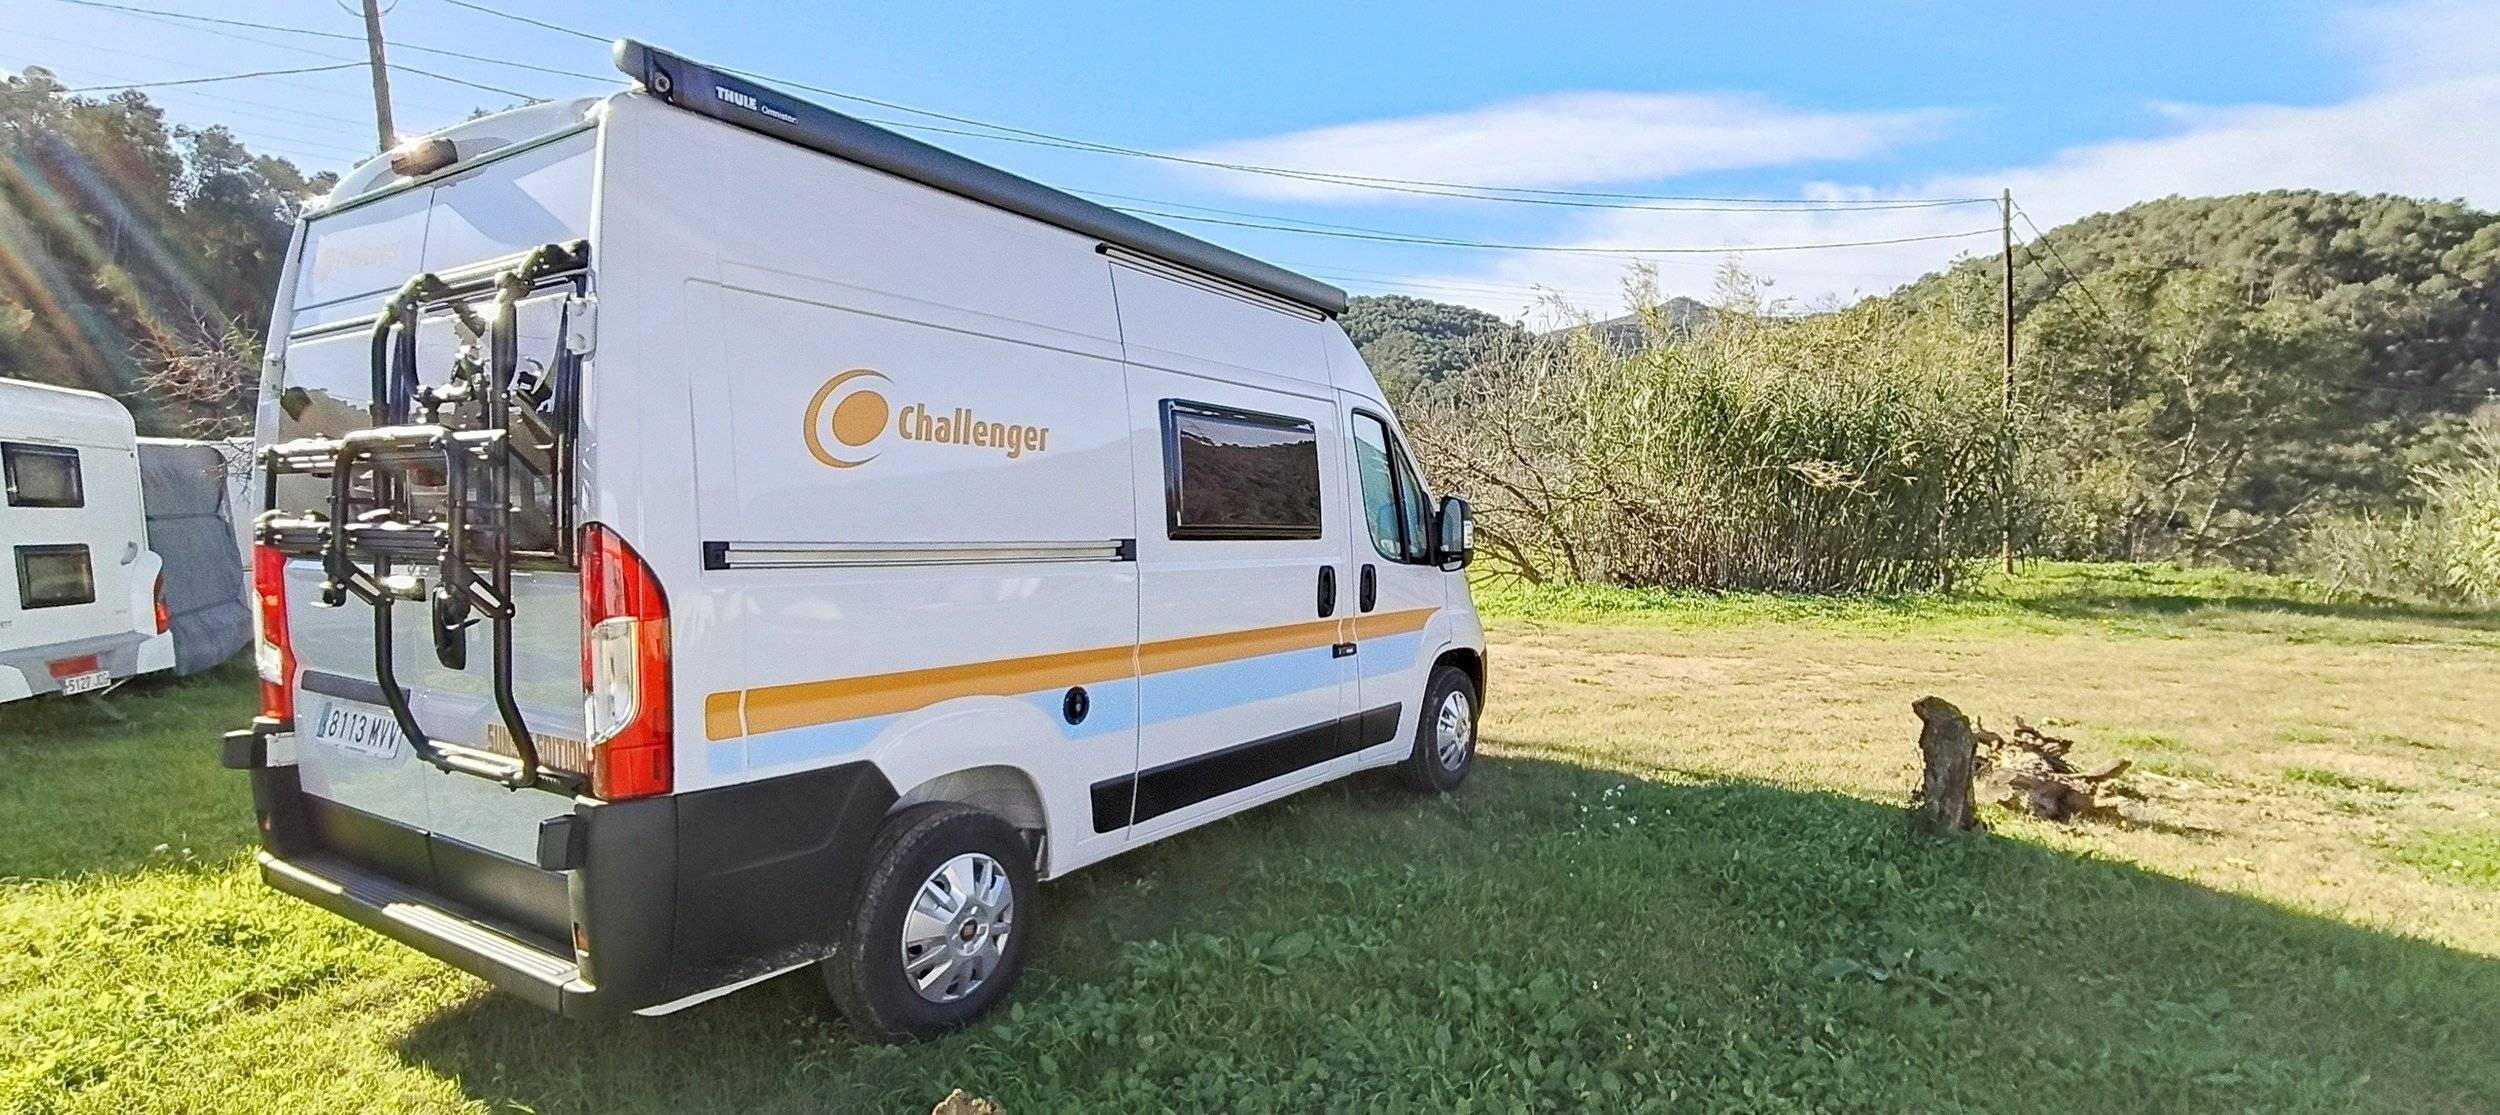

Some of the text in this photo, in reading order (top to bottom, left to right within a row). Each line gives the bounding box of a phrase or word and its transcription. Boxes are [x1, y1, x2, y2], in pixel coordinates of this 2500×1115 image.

[715, 86, 757, 111] THULE
[899, 403, 1049, 459] Challenger
[328, 709, 400, 750] 8113 MVV
